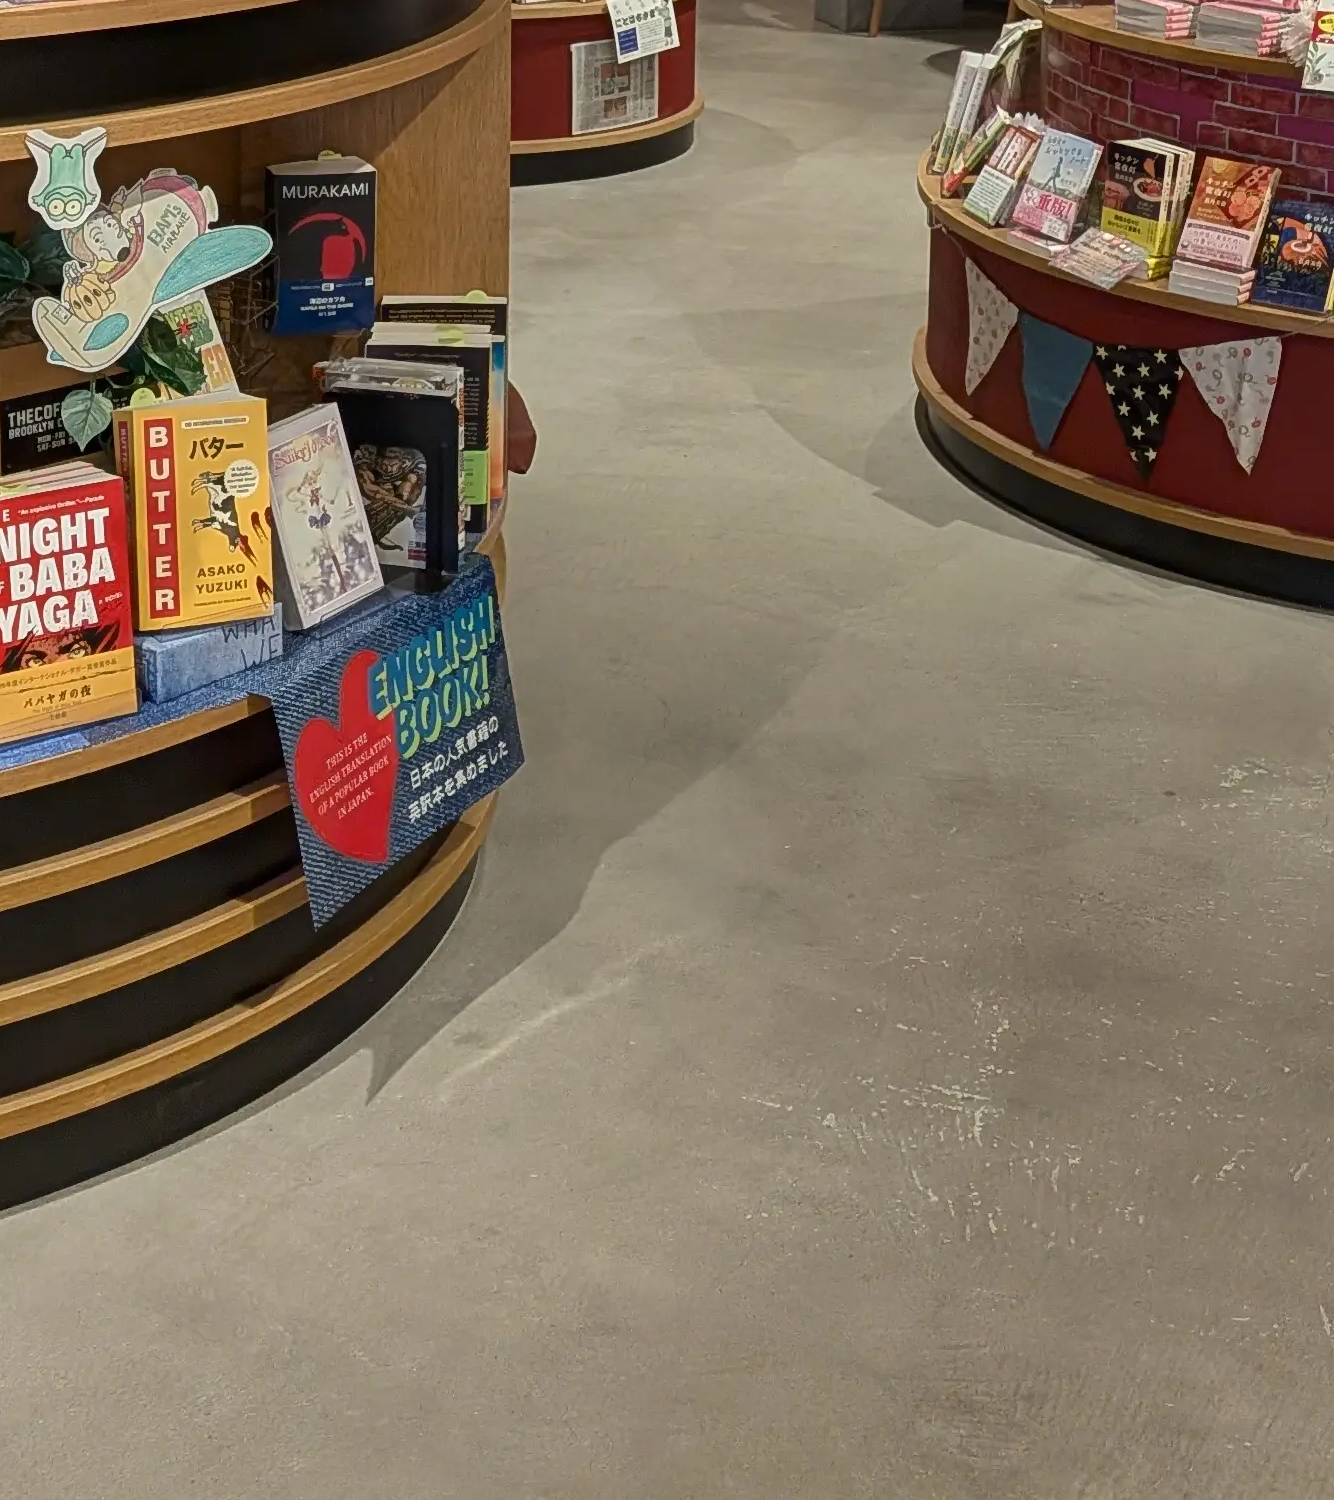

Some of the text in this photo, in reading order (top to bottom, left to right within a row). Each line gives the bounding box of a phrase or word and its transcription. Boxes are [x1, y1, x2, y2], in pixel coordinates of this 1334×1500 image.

[282, 182, 369, 199] MURAKAMI
[8, 420, 55, 440] BROOKLYN
[188, 436, 244, 461] バター
[148, 425, 176, 612] BUTTER
[9, 547, 116, 602] BABA
[196, 578, 248, 595] YUZUKI
[197, 563, 246, 578] ASAKO
[368, 595, 496, 720] ENGLISH
[394, 655, 491, 758] BOOK!
[309, 734, 392, 803] ENGLISH TRANSLATION
[325, 748, 344, 771] THIS
[352, 732, 368, 754] THE
[409, 715, 499, 791] 日本の人気書籍の
[318, 801, 328, 816] OF
[335, 771, 368, 801] POPULAR
[369, 757, 390, 780] BOOK
[407, 742, 509, 824] 英訳本を集めました
[338, 807, 347, 820] IN
